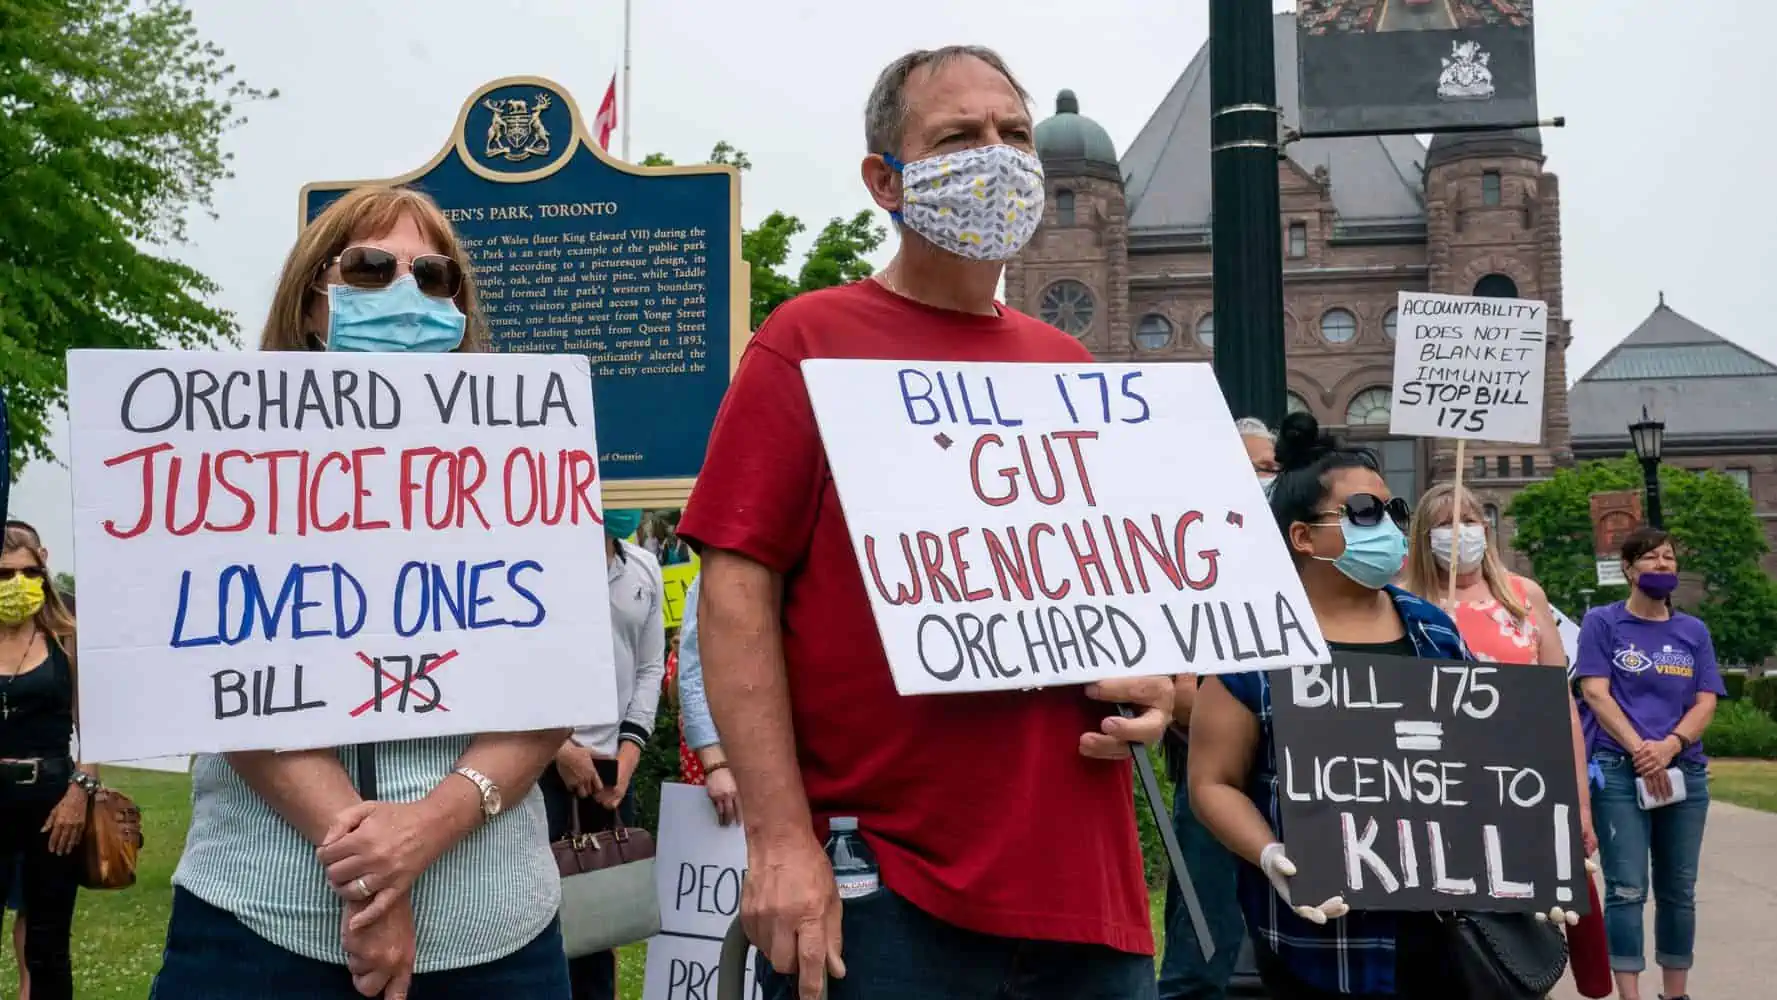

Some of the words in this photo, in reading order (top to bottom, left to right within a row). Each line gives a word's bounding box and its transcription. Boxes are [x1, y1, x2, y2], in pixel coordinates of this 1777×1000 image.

[442, 207, 484, 221] EEN'S
[490, 205, 533, 220] PARK,
[538, 202, 617, 217] TORONTO
[487, 235, 497, 246] of
[502, 234, 529, 246] Wales
[533, 233, 559, 245] (later
[563, 231, 585, 244] King
[590, 230, 626, 241] Edward
[630, 229, 650, 241] VII)
[654, 227, 687, 239] during
[690, 225, 706, 236] the
[483, 249, 504, 259] Park
[509, 249, 517, 258] is
[522, 249, 534, 257] an
[538, 246, 561, 258] early
[567, 245, 608, 257] example
[612, 243, 623, 254] of
[628, 243, 643, 253] the
[648, 240, 679, 254] public
[683, 239, 706, 253] park
[509, 260, 557, 273] according
[563, 260, 574, 270] to
[579, 261, 585, 269] a
[591, 257, 648, 271] picturesque
[653, 255, 688, 267] design,
[694, 253, 706, 263] its
[536, 272, 553, 284] elm
[558, 272, 577, 283] and
[581, 270, 608, 281] white
[642, 267, 669, 279] while
[673, 265, 706, 278] Taddle
[480, 289, 504, 299] Pond
[511, 288, 546, 299] formed
[553, 287, 569, 297] the
[613, 284, 650, 295] western
[530, 300, 565, 311] visitors
[571, 298, 603, 311] gained
[608, 298, 639, 308] access
[645, 297, 656, 306] to
[661, 296, 677, 305] the
[683, 294, 706, 306] park
[1403, 300, 1540, 319] ACCOUNTABILITY
[525, 315, 544, 325] one
[548, 314, 584, 326] leading
[588, 312, 610, 323] west
[615, 311, 639, 321] from
[643, 309, 672, 322] Yonge
[676, 307, 706, 319] Street
[500, 329, 528, 338] other
[533, 327, 569, 339] leading
[574, 325, 602, 336] north
[608, 324, 632, 335] from
[638, 323, 671, 335] Queen
[676, 320, 706, 332] Street
[1416, 325, 1463, 340] DOES
[1474, 327, 1517, 341] NOT
[508, 341, 557, 352] legislative
[563, 339, 608, 351] building,
[615, 337, 652, 349] opened
[659, 336, 669, 346] in
[1419, 343, 1533, 362] BLANKET
[649, 349, 684, 360] altered
[690, 349, 706, 358] the
[599, 365, 615, 376] the
[619, 364, 638, 376] city
[641, 363, 686, 375] encircled
[690, 361, 706, 372] the
[1416, 366, 1531, 385] IMMUNITY
[120, 368, 401, 433] ORCHARD
[425, 371, 577, 428] VILLA
[898, 368, 1022, 426] BILL
[1056, 371, 1150, 424] 175
[1400, 381, 1471, 406] STOP
[1475, 387, 1528, 406] BILL
[1437, 407, 1488, 432] 175
[104, 442, 391, 540] JUSTICE
[400, 445, 491, 532] FOR
[504, 446, 604, 527] OUR
[170, 562, 368, 648] LOVED
[394, 559, 546, 638] ONES
[917, 604, 1147, 682] ORCHARD
[1160, 591, 1319, 663] VILLA
[1654, 652, 1695, 668] 2020
[213, 664, 327, 720] BILL
[373, 653, 443, 714] 175
[1291, 665, 1404, 709] BILL
[1430, 666, 1500, 719] 175
[1285, 746, 1469, 806] LICENSE
[1483, 765, 1546, 807] TO
